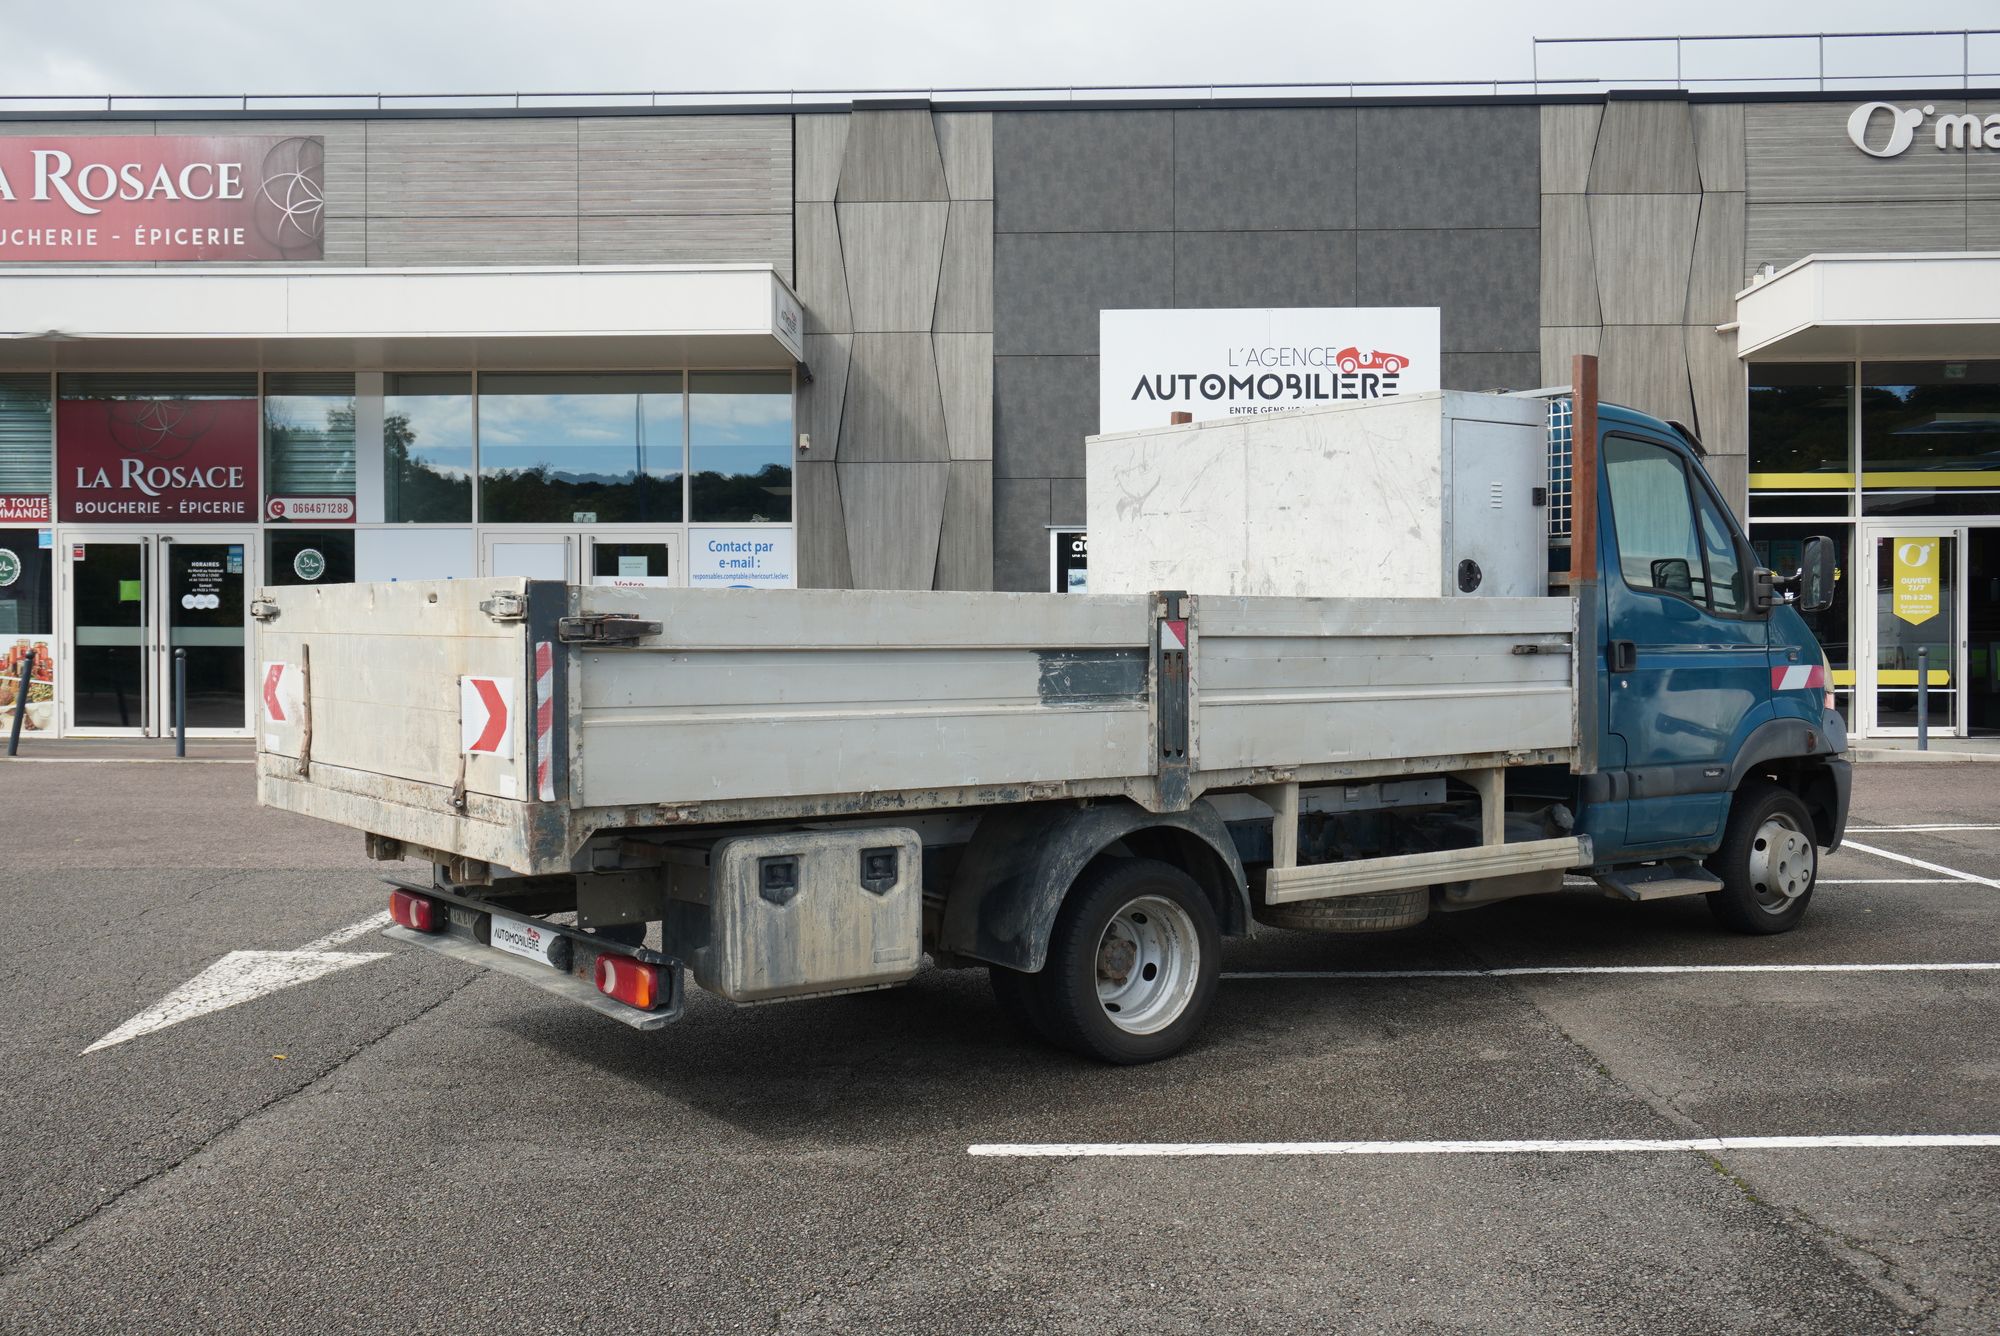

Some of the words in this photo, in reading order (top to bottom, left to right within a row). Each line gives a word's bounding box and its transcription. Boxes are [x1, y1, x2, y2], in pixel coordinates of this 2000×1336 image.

[0, 228, 98, 246] UCHERIE
[134, 225, 245, 246] ÉPICERIE
[1228, 346, 1337, 368] L'AGENCE
[1229, 406, 1258, 415] ENTRE
[76, 466, 113, 489] LA
[10, 498, 48, 508] TOUTE
[75, 502, 160, 514] BOUCHERIE
[179, 500, 245, 514] ÉPICERIE
[292, 503, 349, 514] 0664671288
[708, 540, 752, 553] Contact
[755, 543, 774, 555] par
[719, 556, 754, 569] e-mail
[1900, 577, 1932, 585] OUVERT
